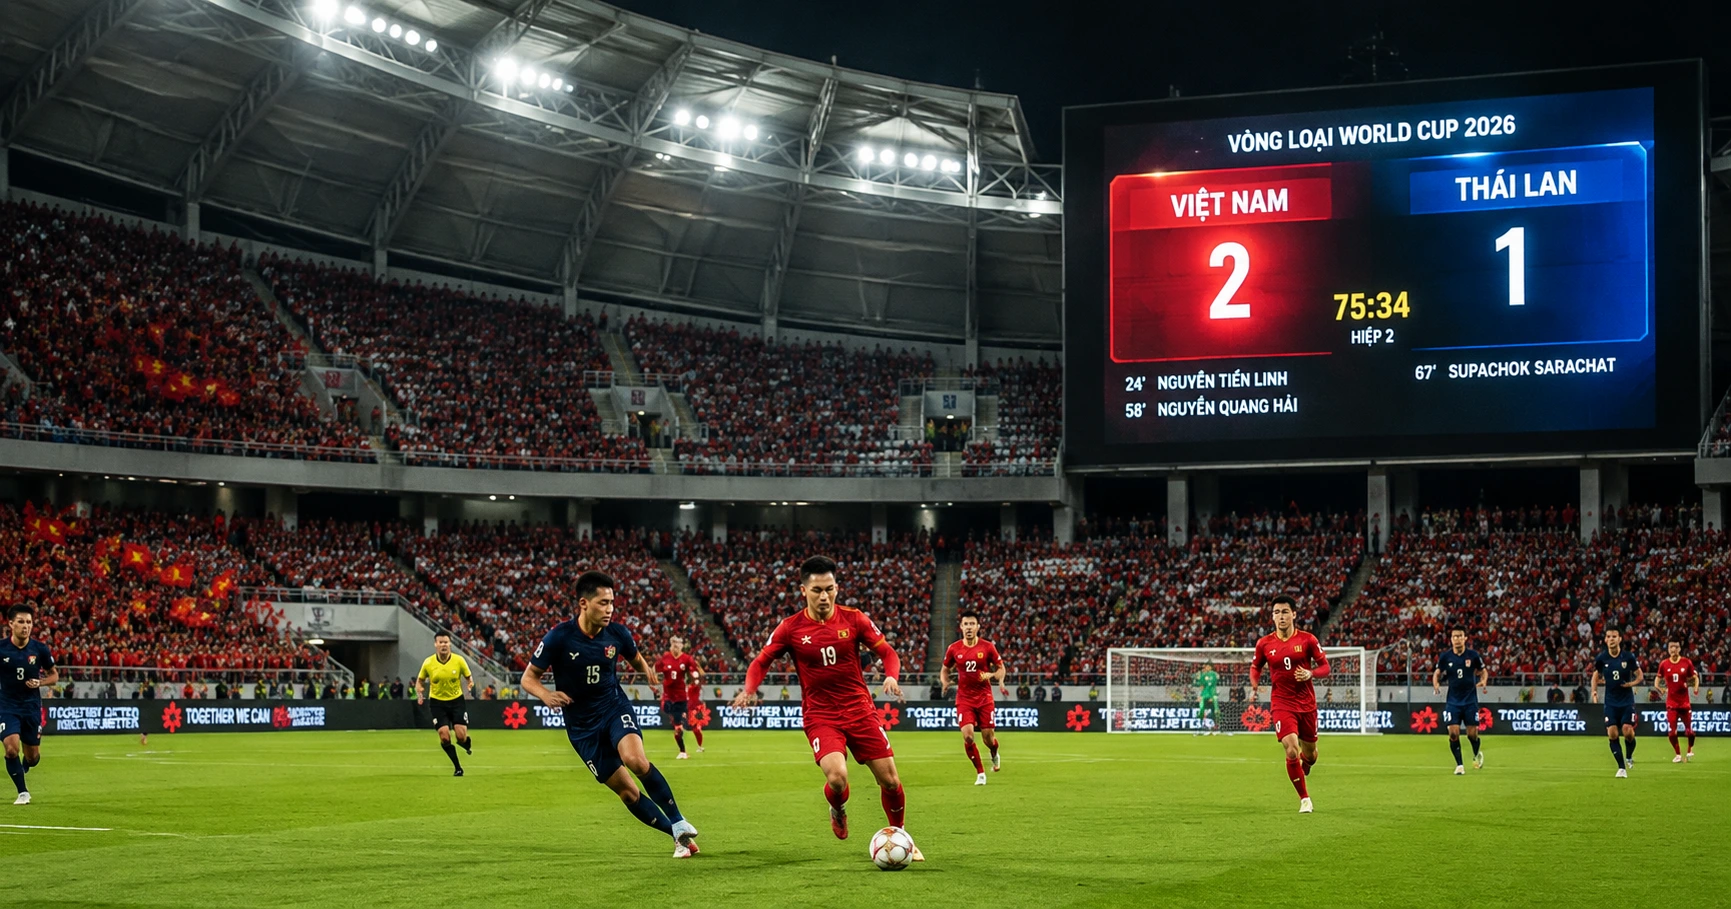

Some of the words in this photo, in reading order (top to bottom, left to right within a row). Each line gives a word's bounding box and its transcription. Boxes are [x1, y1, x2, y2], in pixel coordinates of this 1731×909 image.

[1227, 129, 1283, 153] VÒNG
[1288, 127, 1333, 153] LOẠI
[1338, 122, 1412, 146] WORLD
[1416, 117, 1459, 141] CUP
[1464, 114, 1516, 138] 2026
[1455, 168, 1516, 202] THÁI
[1524, 169, 1577, 198] LAN
[1170, 186, 1225, 222] VIỆT
[1231, 188, 1288, 215] NAM
[1495, 226, 1525, 306] 1
[1209, 241, 1251, 320] 2
[1333, 291, 1410, 321] 75:34
[1350, 325, 1382, 347] HIỆP
[1385, 328, 1395, 344] 2
[1448, 360, 1530, 379] SUPACHOK
[1534, 357, 1617, 376] SARACHAT
[1125, 376, 1146, 392] 24'
[1254, 371, 1288, 387] LINH
[1125, 402, 1147, 418] 58'
[1218, 398, 1269, 417] QUANG
[1273, 394, 1298, 413] HẢI
[820, 645, 836, 667] 19
[965, 660, 977, 673] 22
[1283, 656, 1292, 670] 9
[16, 667, 25, 681] 3
[586, 664, 600, 685] 15
[186, 707, 235, 724] TOGETHER
[236, 707, 251, 724] WE
[251, 707, 271, 724] CAN
